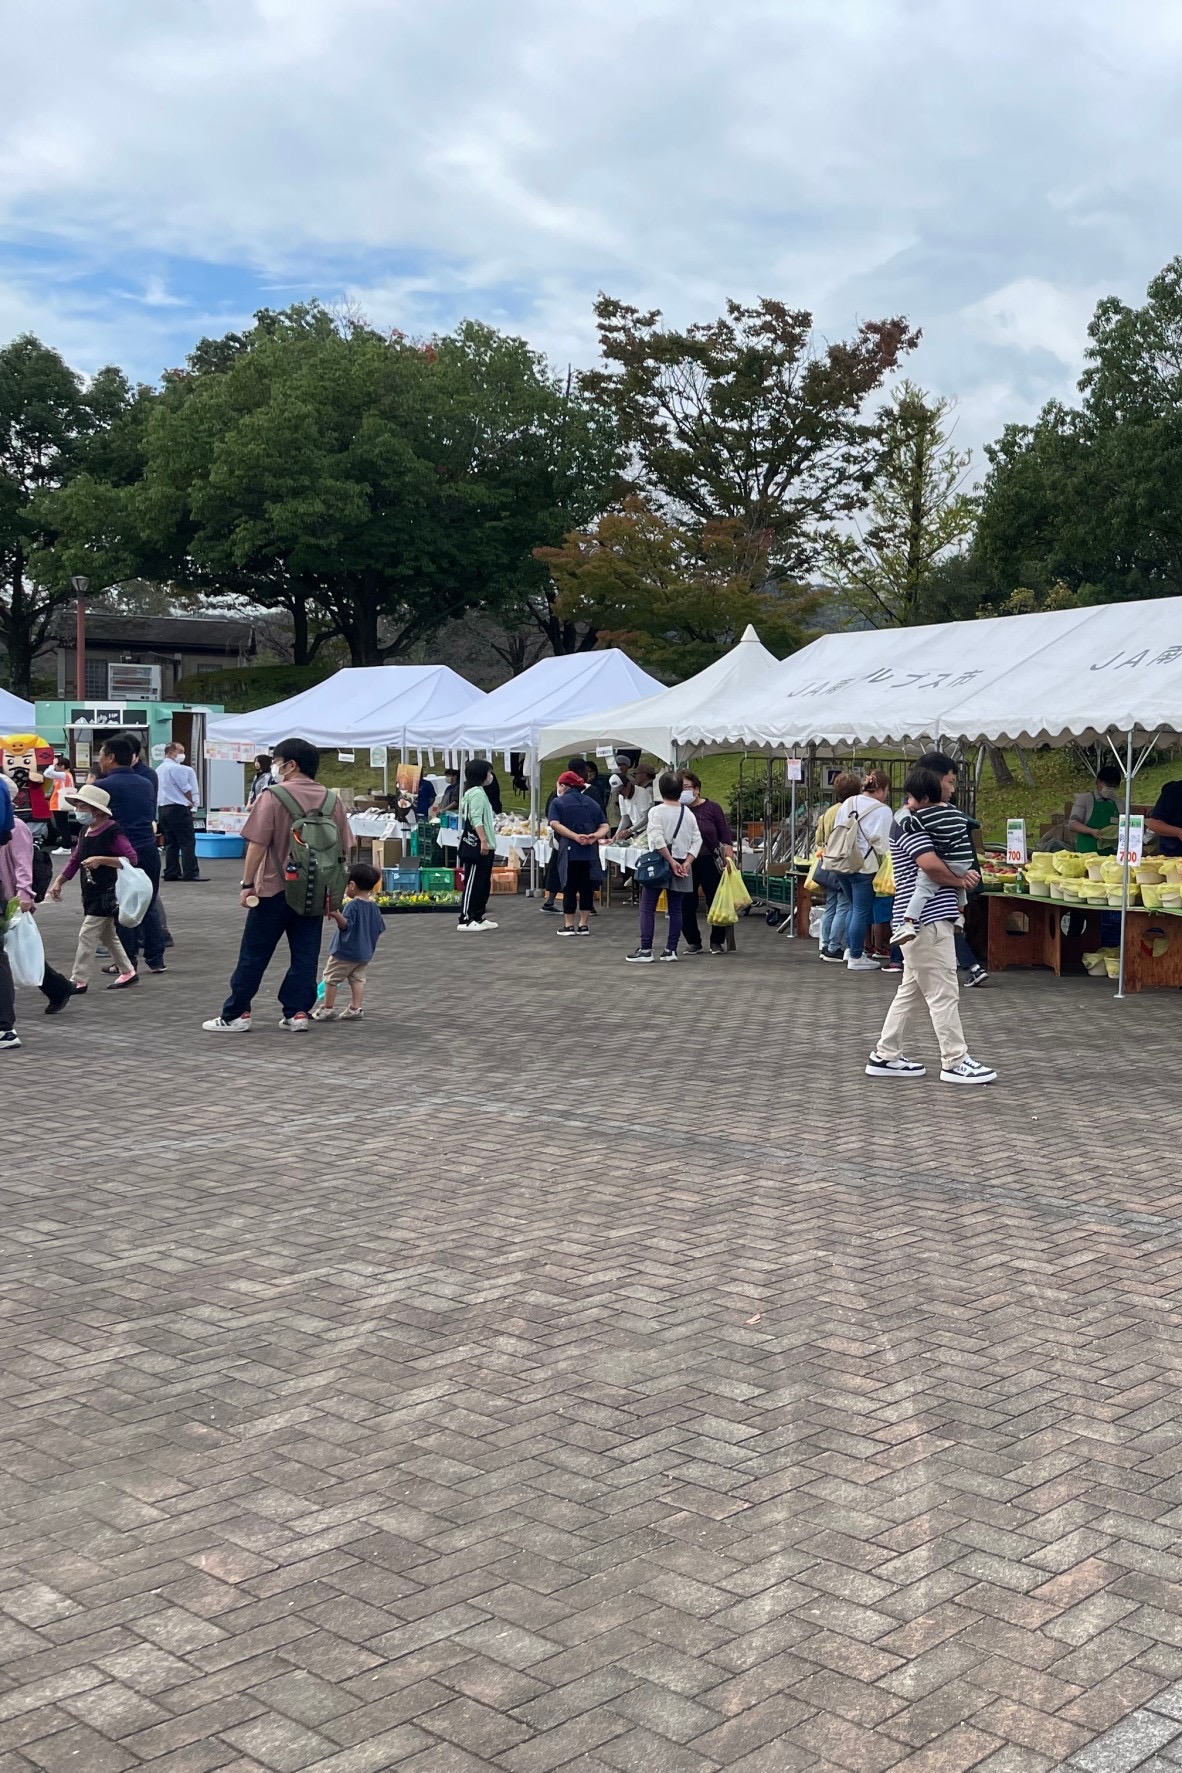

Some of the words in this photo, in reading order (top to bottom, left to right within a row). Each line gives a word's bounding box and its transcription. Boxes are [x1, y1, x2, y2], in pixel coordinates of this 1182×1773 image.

[787, 667, 985, 699] JA南ルプス市
